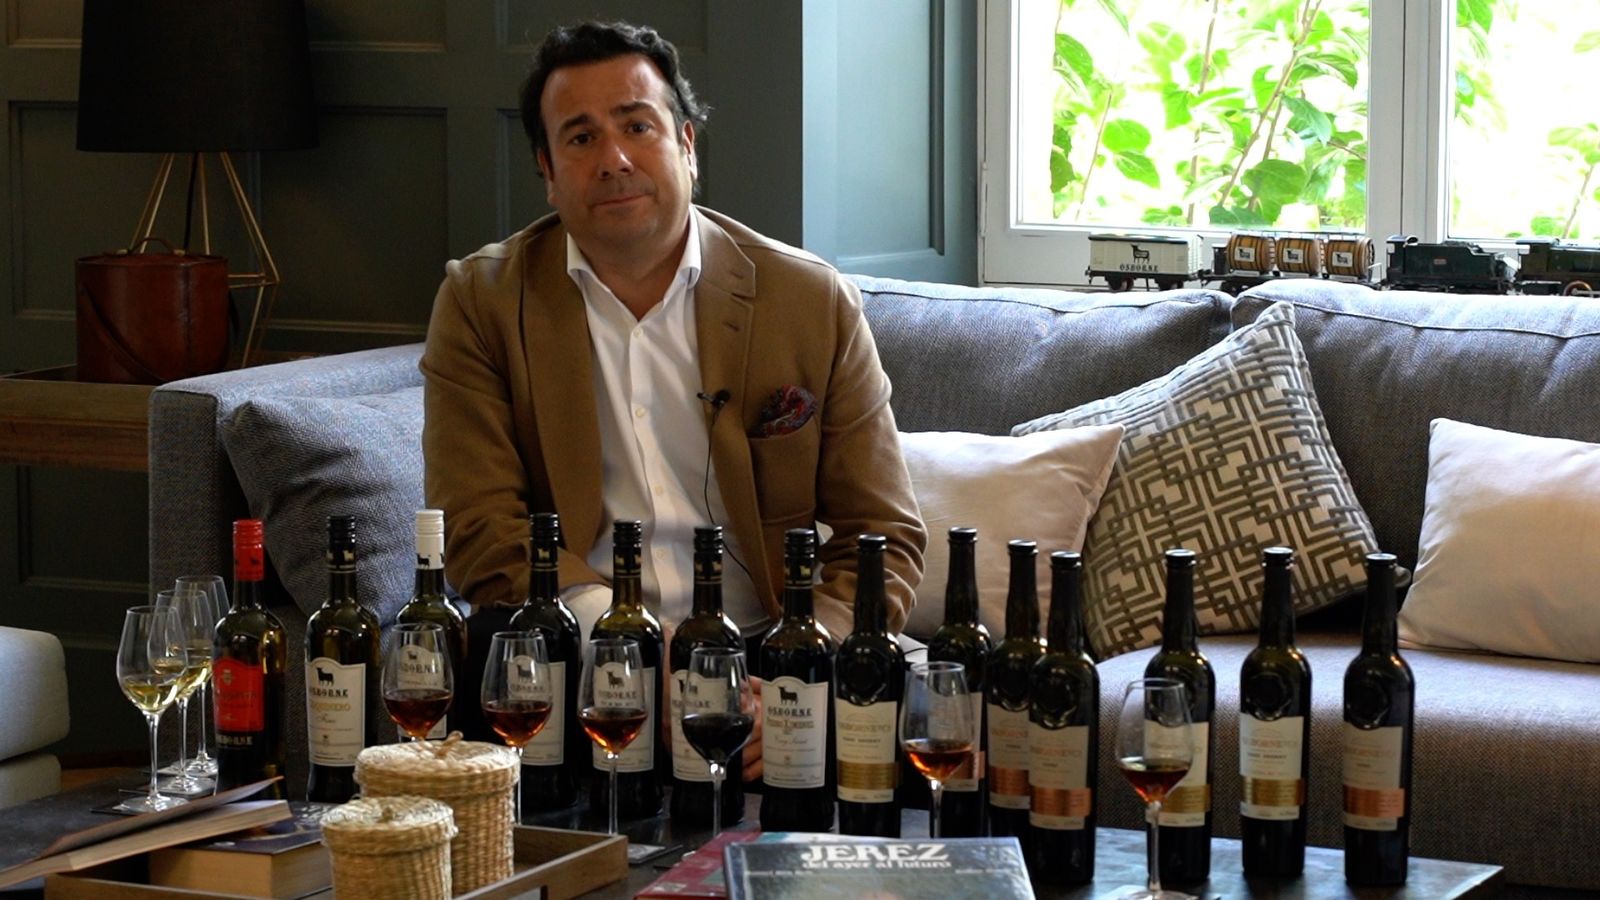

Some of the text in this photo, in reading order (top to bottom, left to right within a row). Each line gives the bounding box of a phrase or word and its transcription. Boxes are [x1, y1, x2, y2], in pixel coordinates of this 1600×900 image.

[1119, 263, 1159, 272] OSBORNE
[767, 705, 813, 717] OSBORNE
[800, 843, 949, 863] JEREZ
